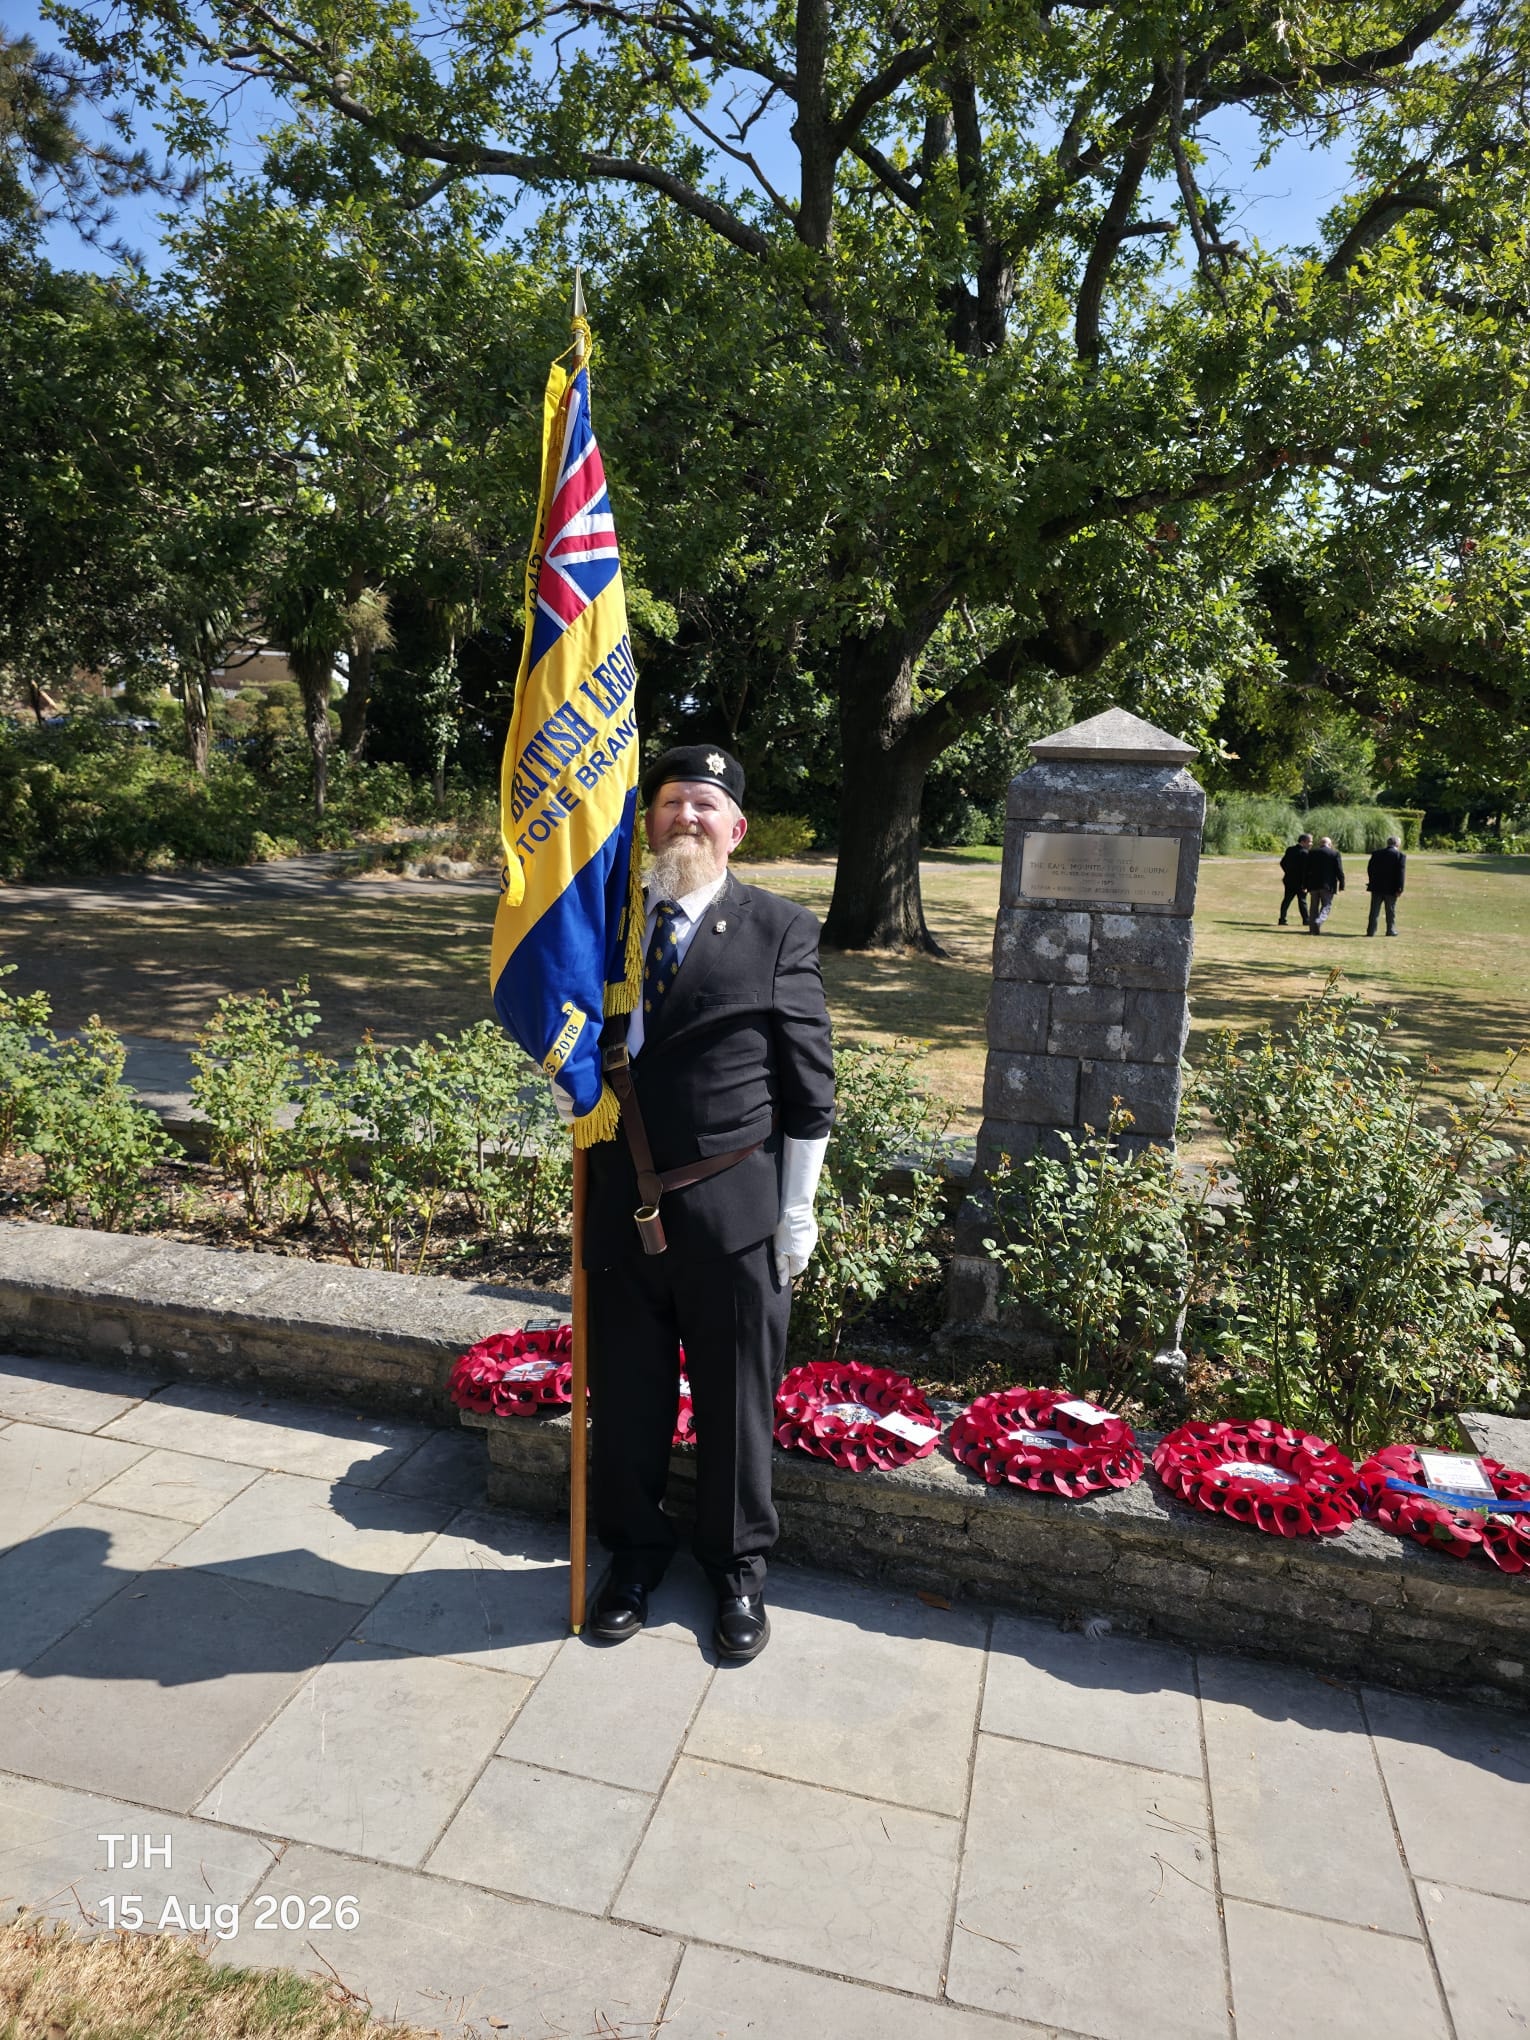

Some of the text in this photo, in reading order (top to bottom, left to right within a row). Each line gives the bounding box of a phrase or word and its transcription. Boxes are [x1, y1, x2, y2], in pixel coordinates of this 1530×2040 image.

[578, 633, 638, 720] LEGIO
[574, 707, 638, 791] BRANC
[553, 1024, 579, 1060] 2018
